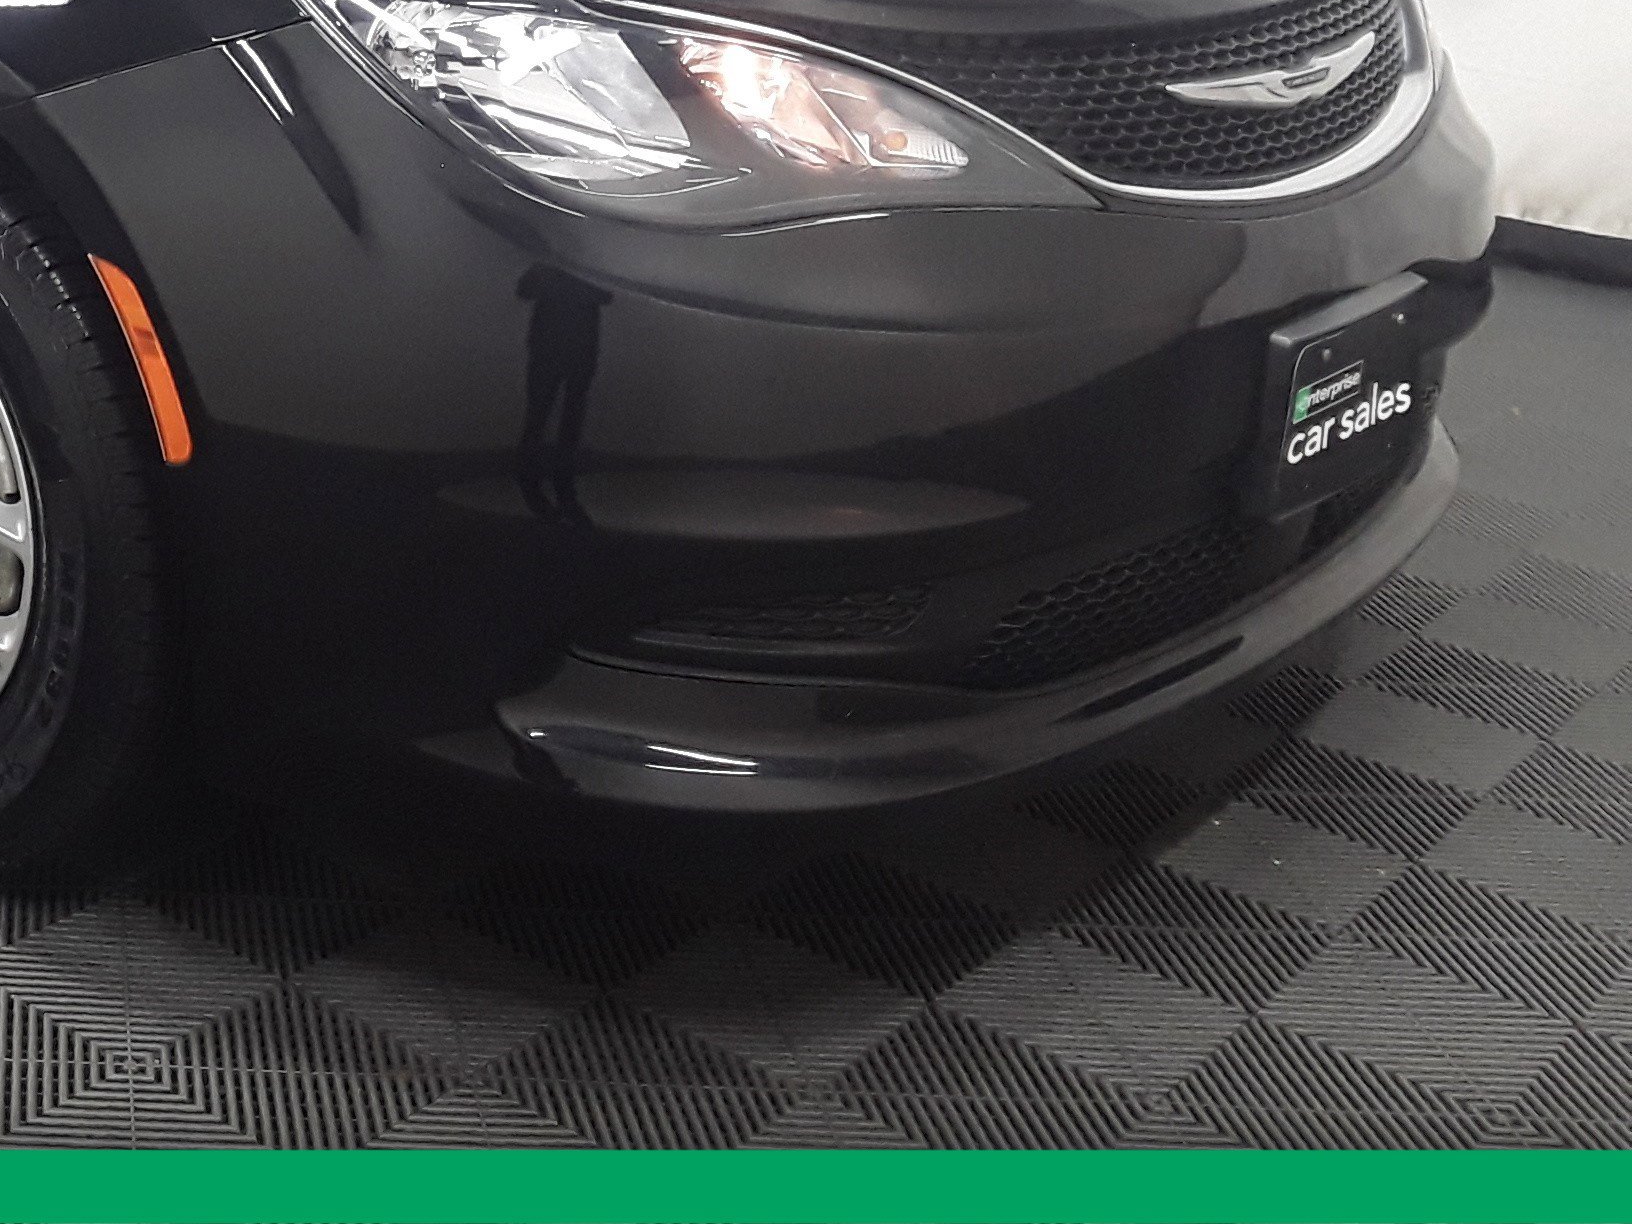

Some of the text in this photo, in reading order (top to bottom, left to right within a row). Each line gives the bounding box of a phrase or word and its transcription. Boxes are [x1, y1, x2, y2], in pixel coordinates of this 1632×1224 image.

[1287, 381, 1412, 464] car sales
[1297, 372, 1361, 413] enterprise
